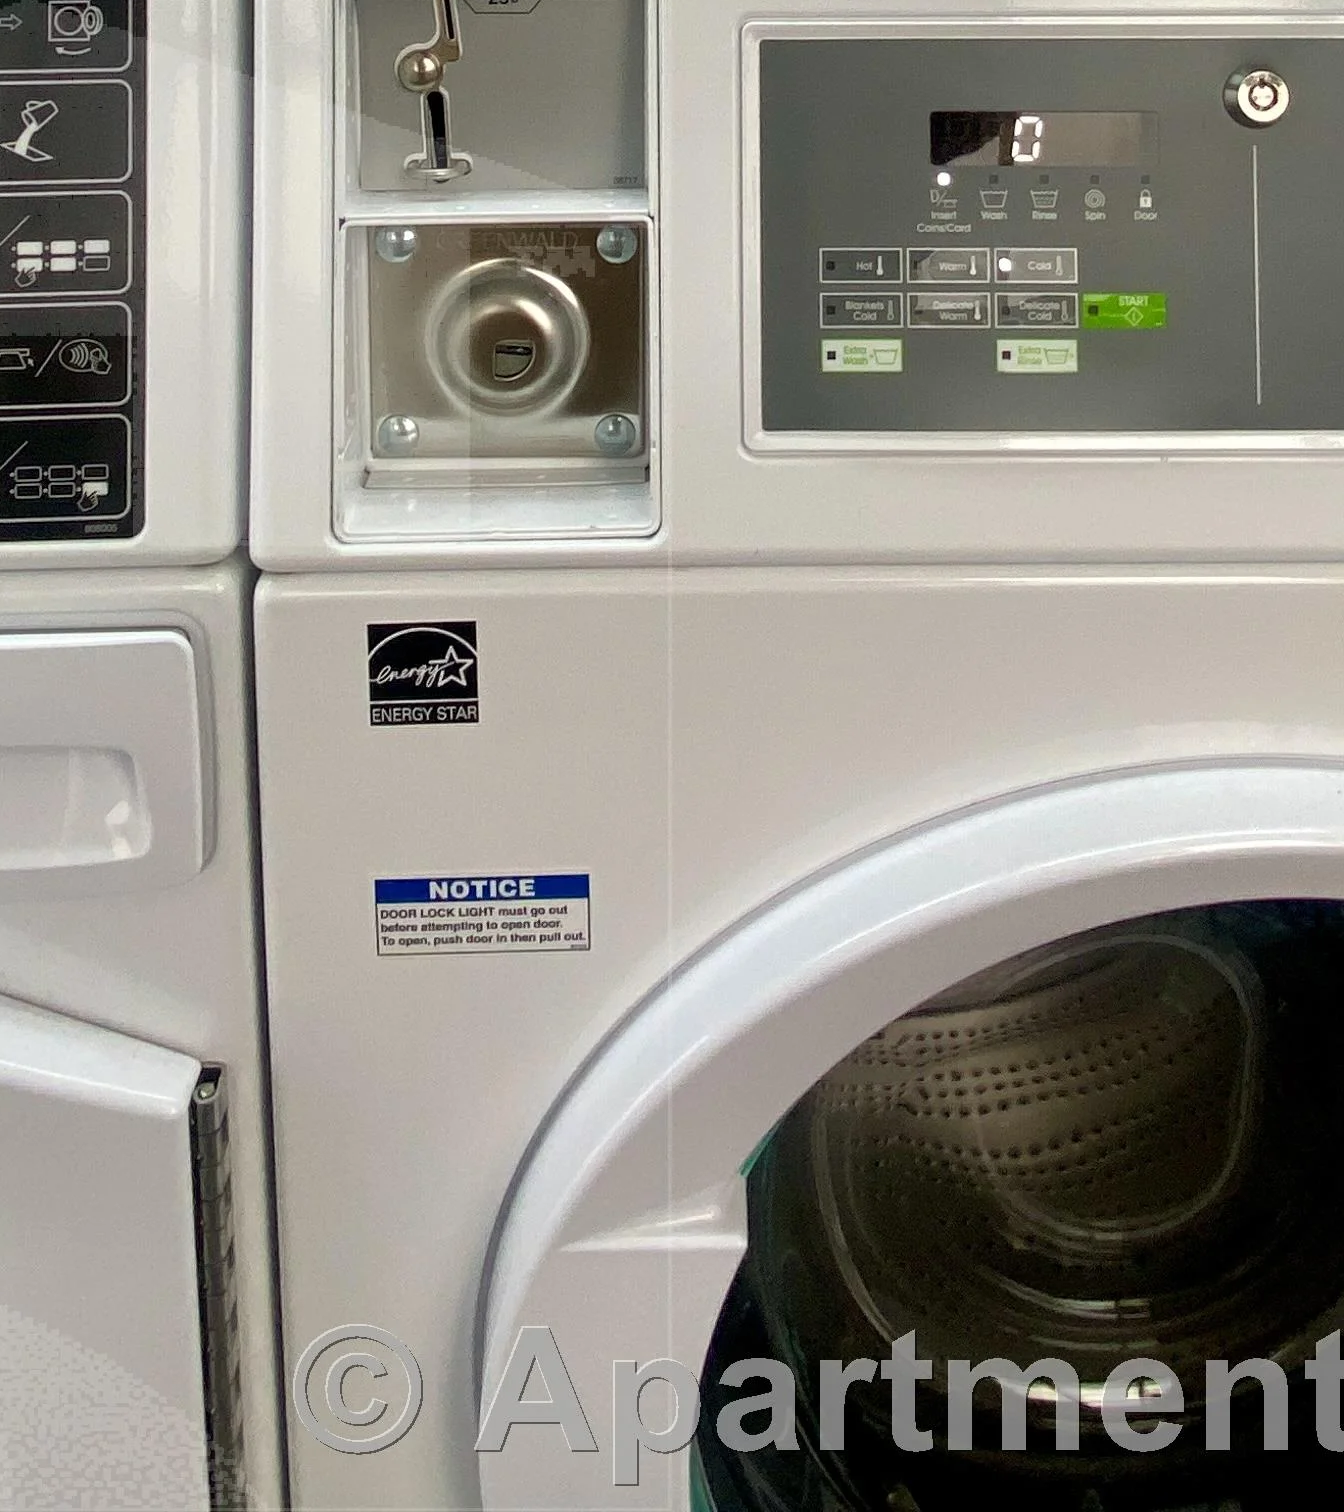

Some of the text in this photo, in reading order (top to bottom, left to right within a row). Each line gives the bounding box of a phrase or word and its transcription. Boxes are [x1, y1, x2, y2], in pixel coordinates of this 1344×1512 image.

[1012, 115, 1043, 162] 0
[931, 210, 956, 220] Insert
[980, 210, 1007, 220] Wash
[1031, 210, 1056, 220] Rinse
[1084, 210, 1105, 222] Spin
[1133, 210, 1157, 220] Door
[916, 222, 972, 234] Coins/Card
[856, 261, 873, 271] Hot
[938, 261, 967, 271] Warm
[1027, 261, 1052, 271] Cold
[1118, 295, 1148, 307] START
[372, 705, 477, 723] ENERGY STAR
[429, 879, 535, 900] NOTICE
[380, 906, 567, 919] DOOR LOCK LIGHT must go out
